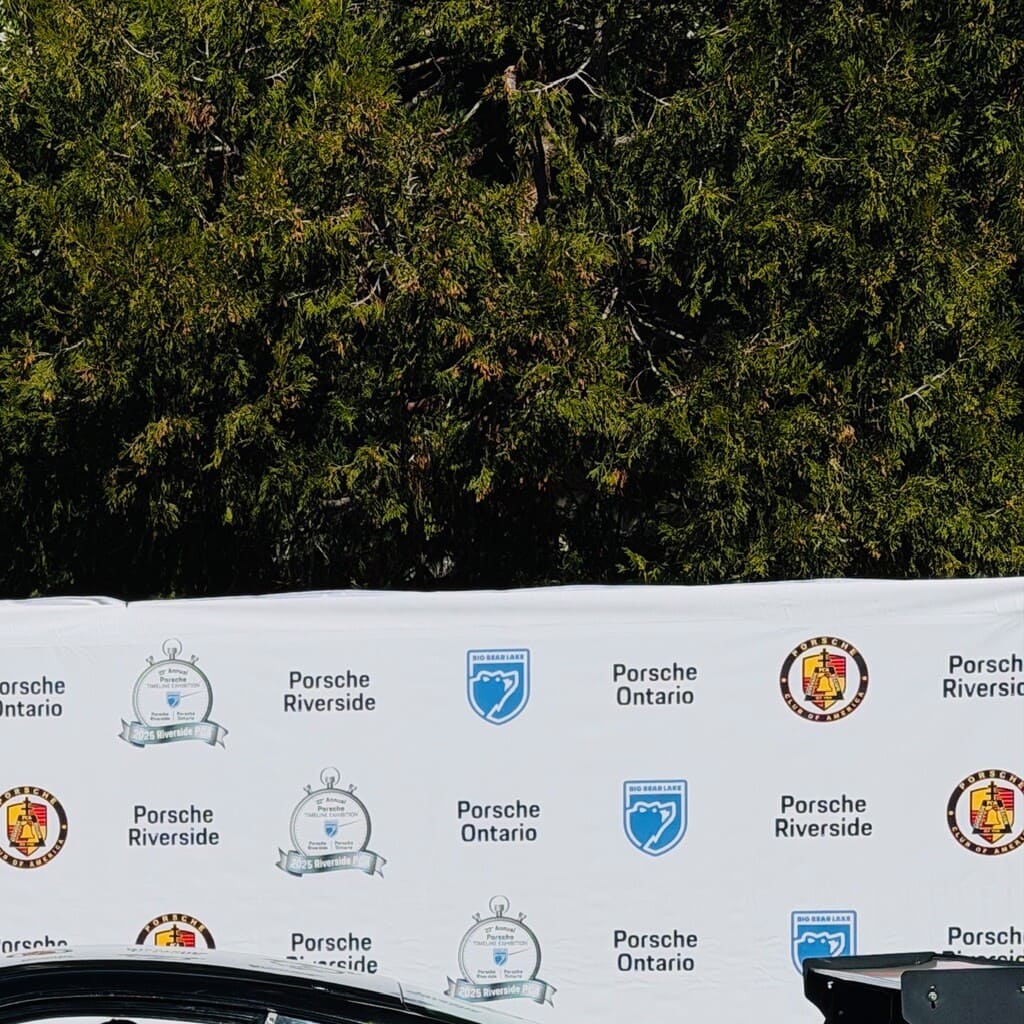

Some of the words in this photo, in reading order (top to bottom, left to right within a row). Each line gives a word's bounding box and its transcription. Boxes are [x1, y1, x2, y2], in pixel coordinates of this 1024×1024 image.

[791, 637, 856, 657] PORSCHE
[614, 663, 697, 682] Porsche
[950, 654, 1022, 674] Porsch
[159, 676, 187, 684] Porsche
[290, 670, 369, 688] Porsche
[284, 693, 375, 712] Riverside
[617, 686, 693, 705] Ontario
[784, 692, 804, 715] CLUB
[826, 691, 865, 720] AMERICA
[156, 727, 193, 738] Riverside
[317, 805, 345, 813] Porsche
[458, 800, 540, 818] Porsche
[782, 795, 866, 813] Porsche
[135, 805, 213, 823] Porsche
[462, 823, 536, 841] Ontario
[776, 817, 872, 837] Riverside
[129, 828, 219, 845] Riverside
[951, 826, 971, 847] CLUB
[975, 846, 987, 854] OF
[29, 839, 64, 867] AMERICA
[314, 857, 351, 868] Riverside
[145, 914, 205, 932] PORSCHE
[291, 932, 371, 951] Porsche
[486, 933, 515, 941] Porsche
[614, 930, 697, 948] Porsche
[948, 926, 1023, 945] Porsch
[618, 953, 694, 971] Ontario
[483, 986, 521, 997] Riverside
